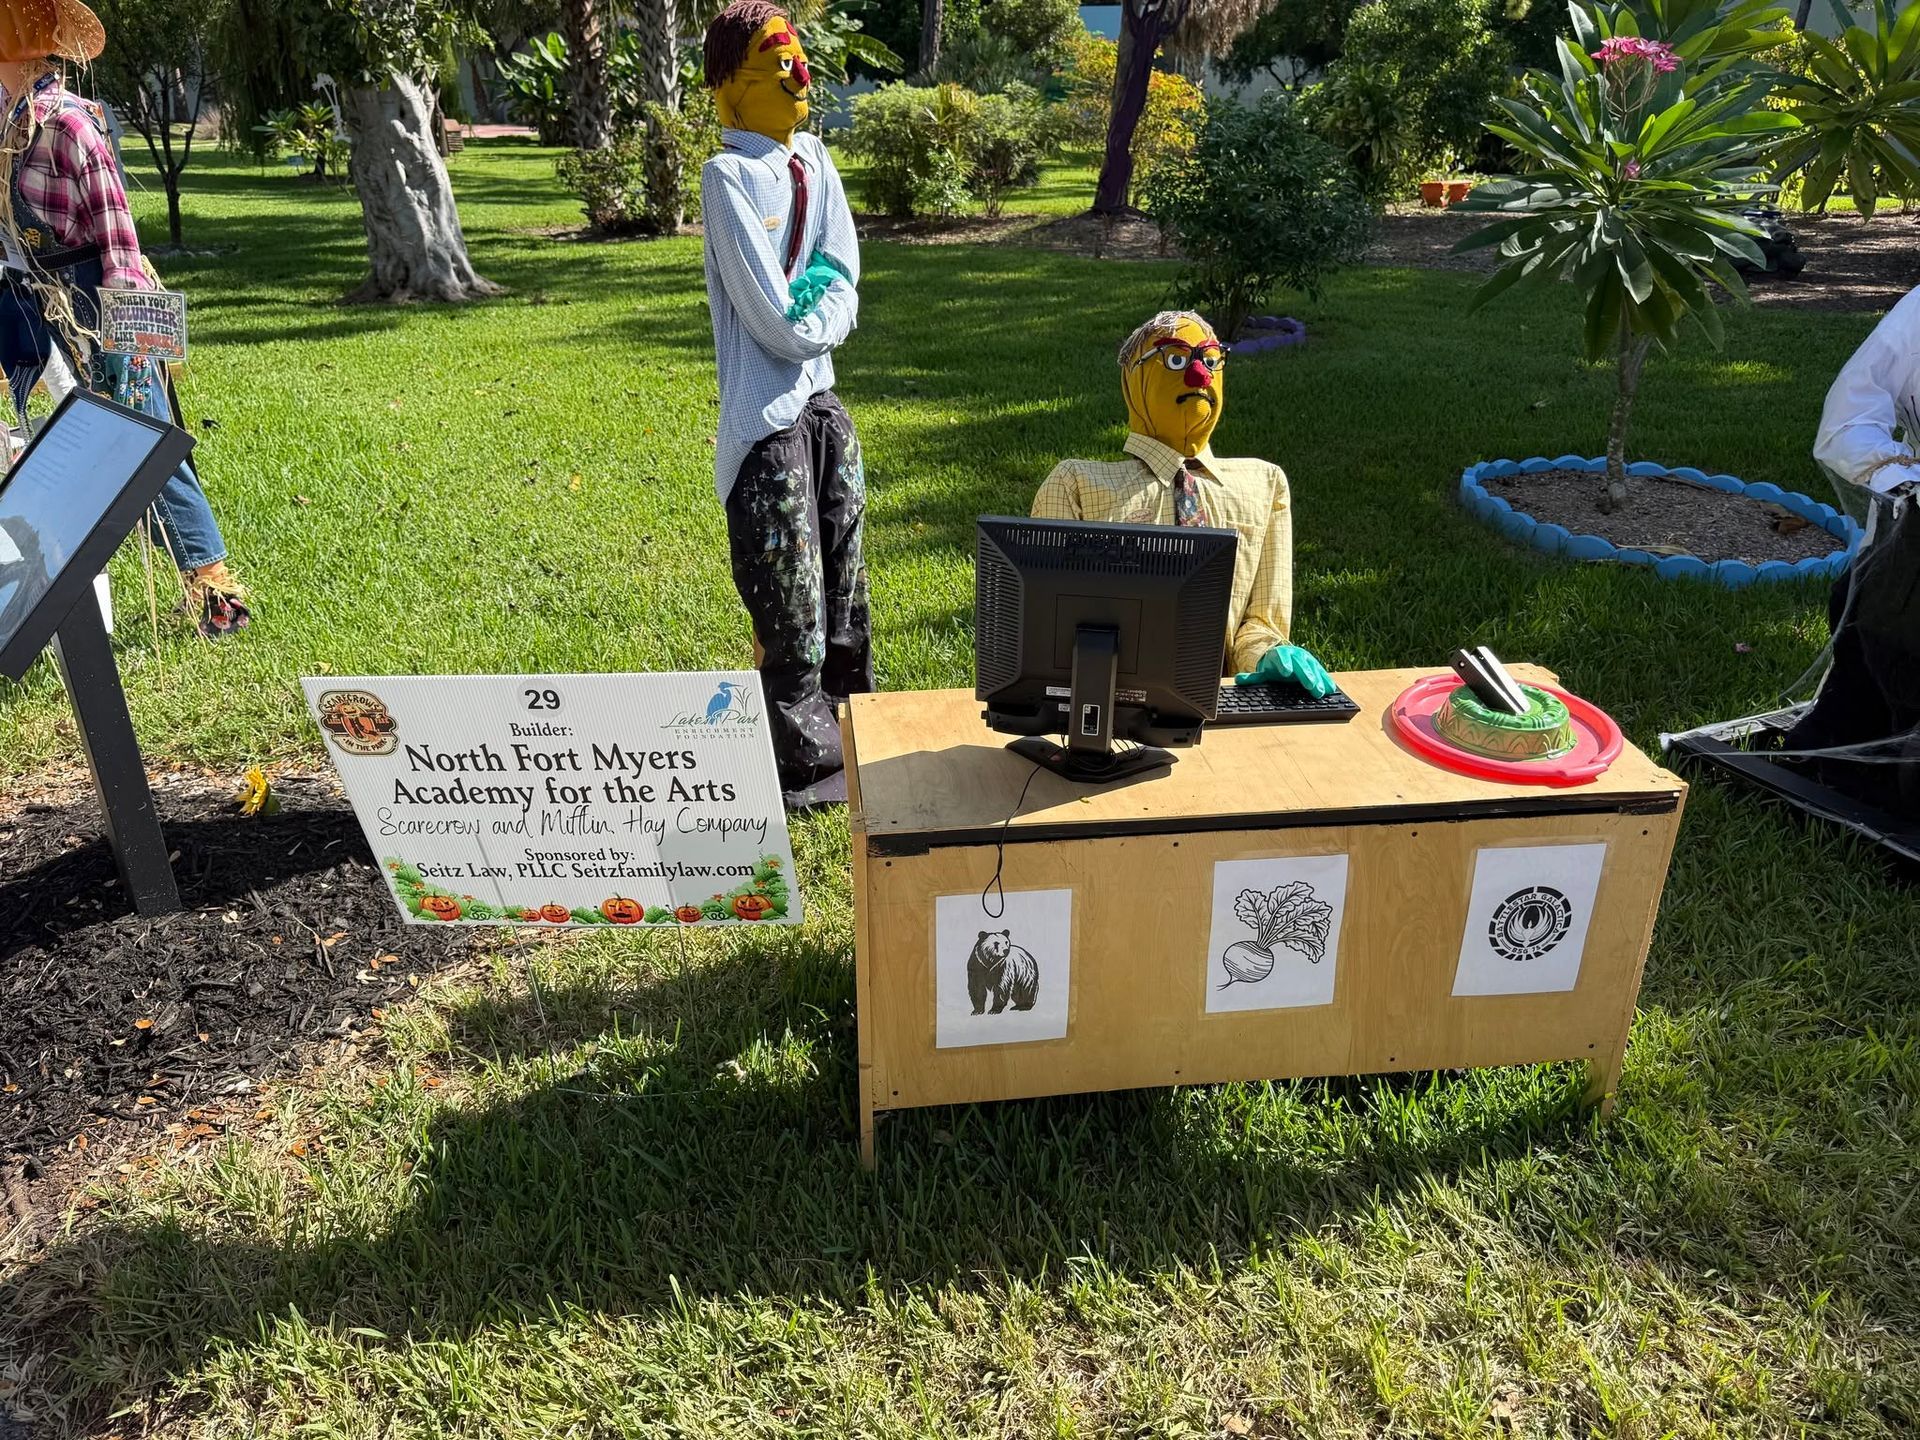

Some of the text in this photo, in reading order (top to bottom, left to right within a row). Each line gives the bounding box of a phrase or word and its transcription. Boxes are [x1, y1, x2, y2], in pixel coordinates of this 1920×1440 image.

[117, 295, 166, 310] WHEN YOU
[111, 306, 178, 328] VOLUNTEER
[115, 322, 174, 336] IT DOESN'T FEEL
[114, 332, 174, 348] LIKE WORK!
[323, 694, 380, 710] SCARECROWS
[524, 689, 561, 710] 29
[660, 708, 761, 728] Lakes Park
[509, 723, 573, 737] Builder:
[345, 739, 354, 747] IN
[371, 740, 387, 751] PARK
[405, 743, 697, 778] North Fort Myers
[393, 777, 736, 813] Academy for the Arts
[377, 807, 480, 836] Scarecrow
[492, 805, 534, 838] and
[623, 805, 665, 846] Hay
[676, 807, 769, 845] Company
[524, 848, 636, 864] Sponsored by:
[417, 861, 756, 882] Seitz Law, PLLC Seitzfamilylaw.com
[1496, 893, 1564, 938] BATTLESTAR GALACTICA
